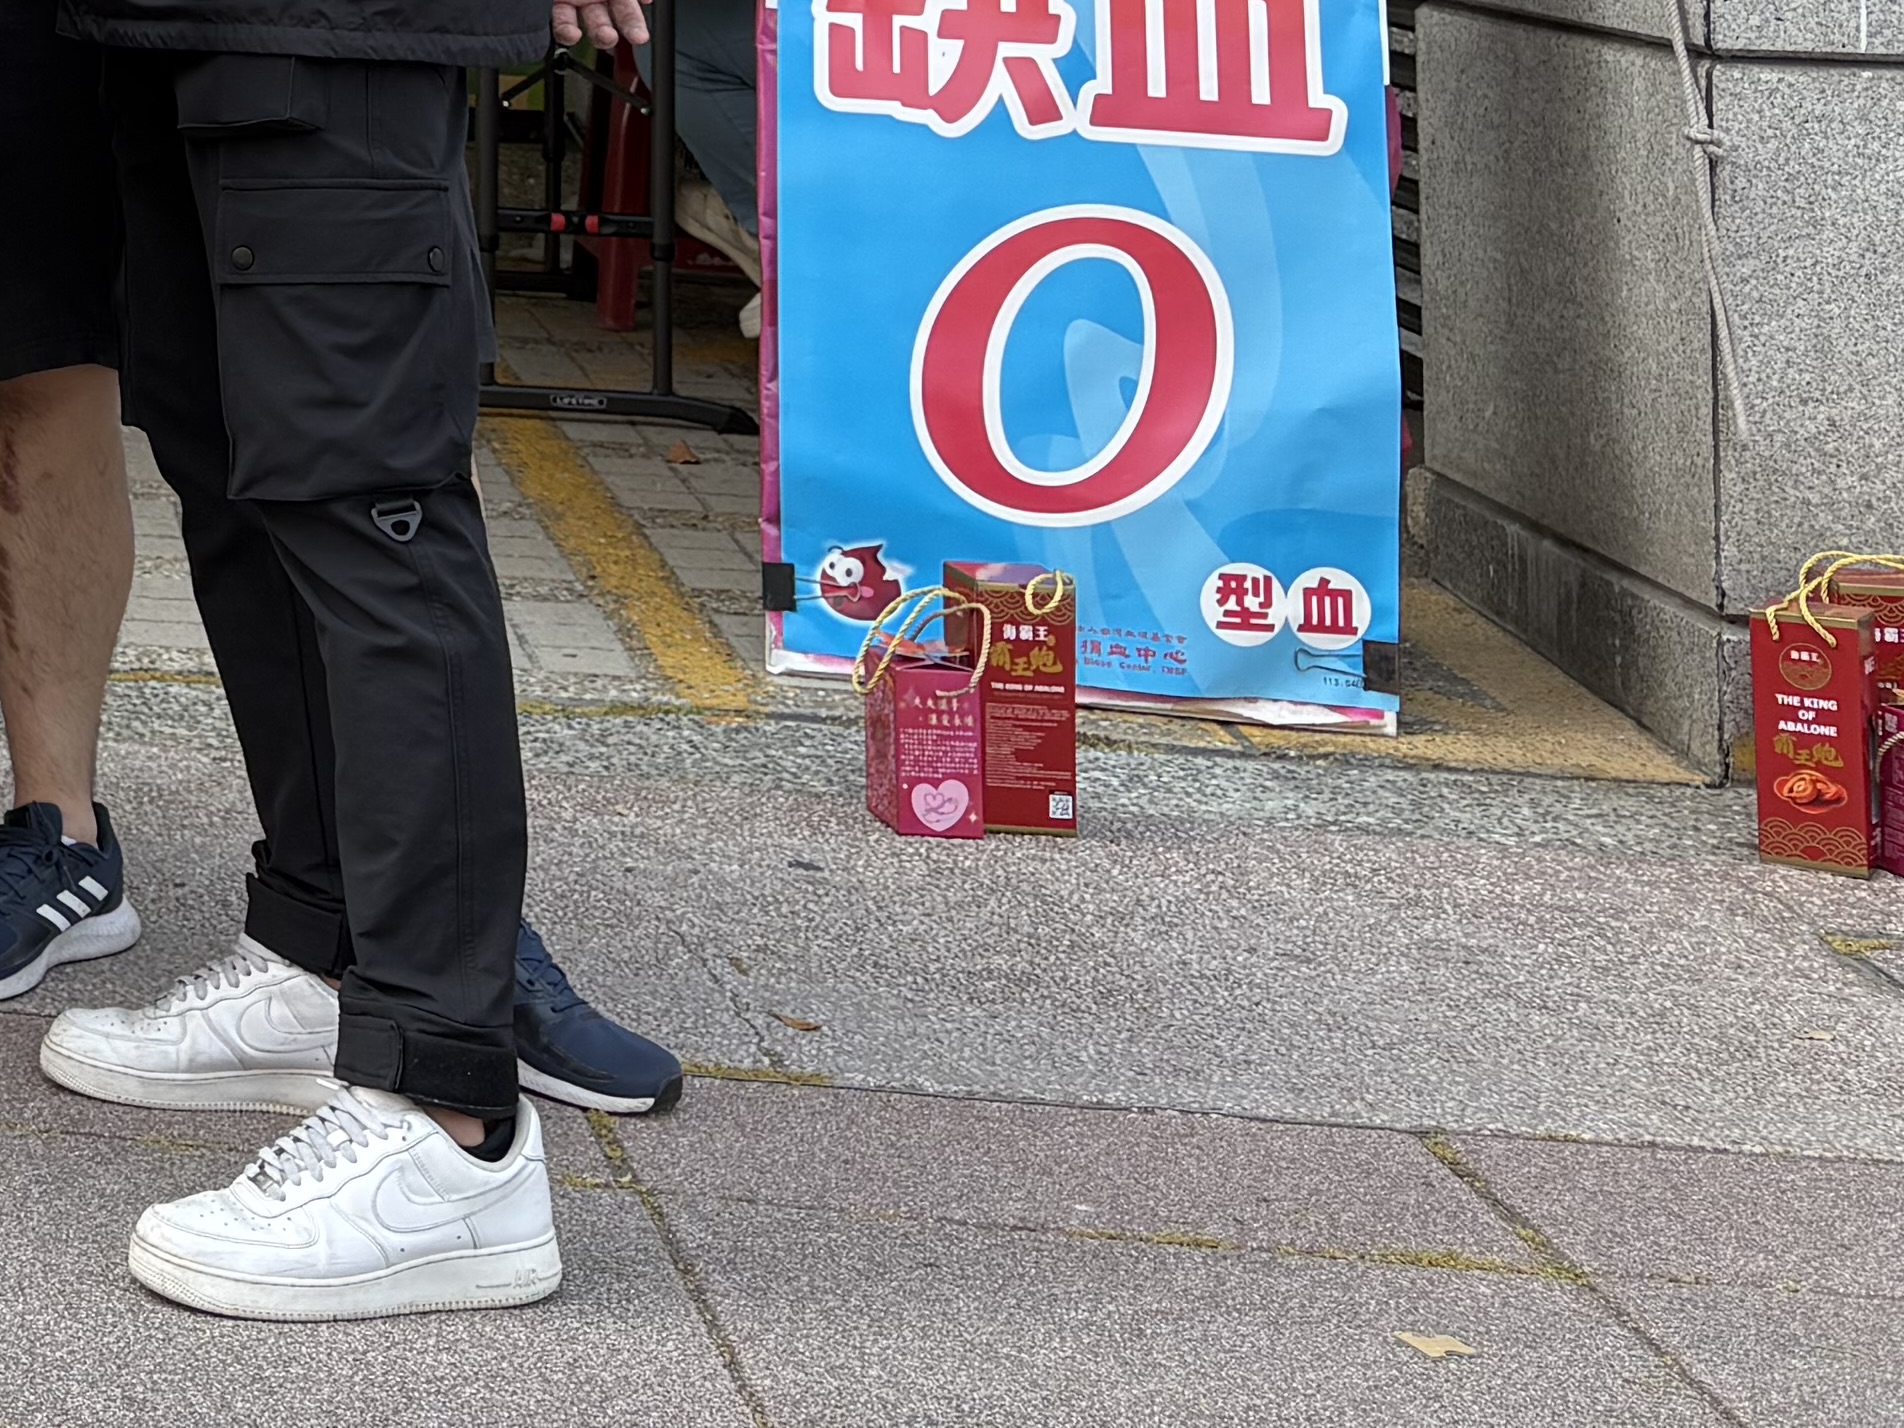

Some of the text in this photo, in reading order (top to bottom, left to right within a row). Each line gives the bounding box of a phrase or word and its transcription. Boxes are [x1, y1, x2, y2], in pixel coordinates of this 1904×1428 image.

[1775, 694, 1838, 710] THE KING
[1798, 710, 1816, 721] OF
[1778, 720, 1838, 737] ABALONE
